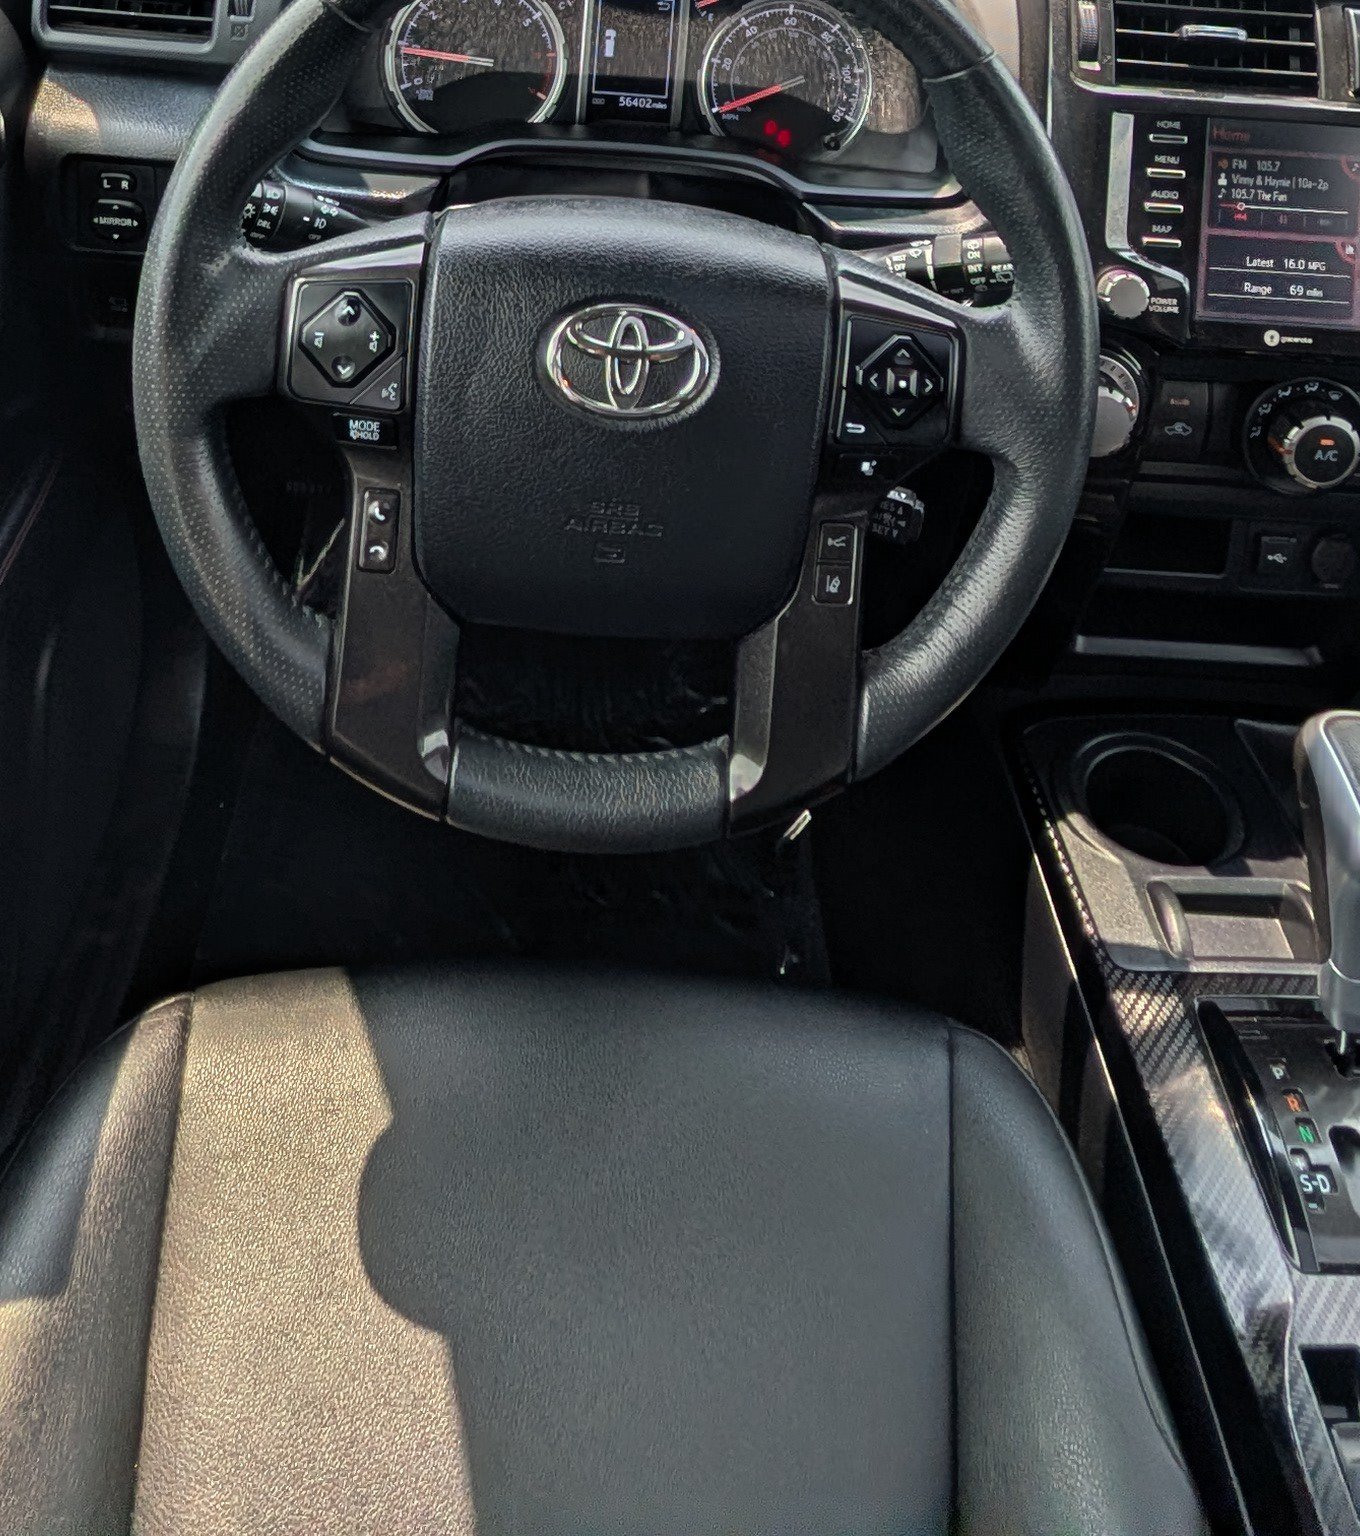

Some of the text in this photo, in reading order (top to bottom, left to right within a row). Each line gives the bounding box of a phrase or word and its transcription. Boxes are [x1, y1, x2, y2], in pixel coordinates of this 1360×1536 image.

[428, 11, 438, 20] 2
[523, 19, 532, 27] 5
[784, 17, 797, 26] 60
[745, 26, 758, 38] 40
[821, 31, 834, 43] 80
[722, 57, 732, 70] 20
[841, 66, 851, 83] 100
[414, 77, 422, 85] 0
[619, 96, 652, 108] 56402
[832, 106, 845, 122] 120
[1156, 120, 1181, 129] HOME
[1154, 155, 1180, 164] MENU
[1232, 159, 1281, 172] FM 105.7
[103, 179, 129, 190] L R
[1256, 175, 1262, 185] &
[1151, 190, 1179, 199] AUDIO
[1231, 188, 1287, 202] 105.7 The Fan
[99, 217, 132, 227] MIRROR
[257, 219, 271, 230] DRL
[1152, 225, 1172, 233] MAP
[967, 250, 981, 259] ON
[967, 264, 983, 273] INT
[1246, 256, 1326, 271] Latest 16.0 MPG
[970, 277, 986, 285] OFF
[1244, 282, 1272, 295] Range
[1289, 285, 1304, 296] 69
[1150, 297, 1177, 305] POWER
[1148, 305, 1179, 314] VOLUME
[349, 419, 380, 432] MODE
[359, 432, 380, 441] HOLD
[1315, 450, 1338, 462] A/C
[592, 501, 639, 516] SRS
[564, 518, 664, 538] AIRBAG
[1285, 1094, 1302, 1113] R
[1298, 1125, 1315, 1144] N
[1299, 1174, 1330, 1193] S-D
